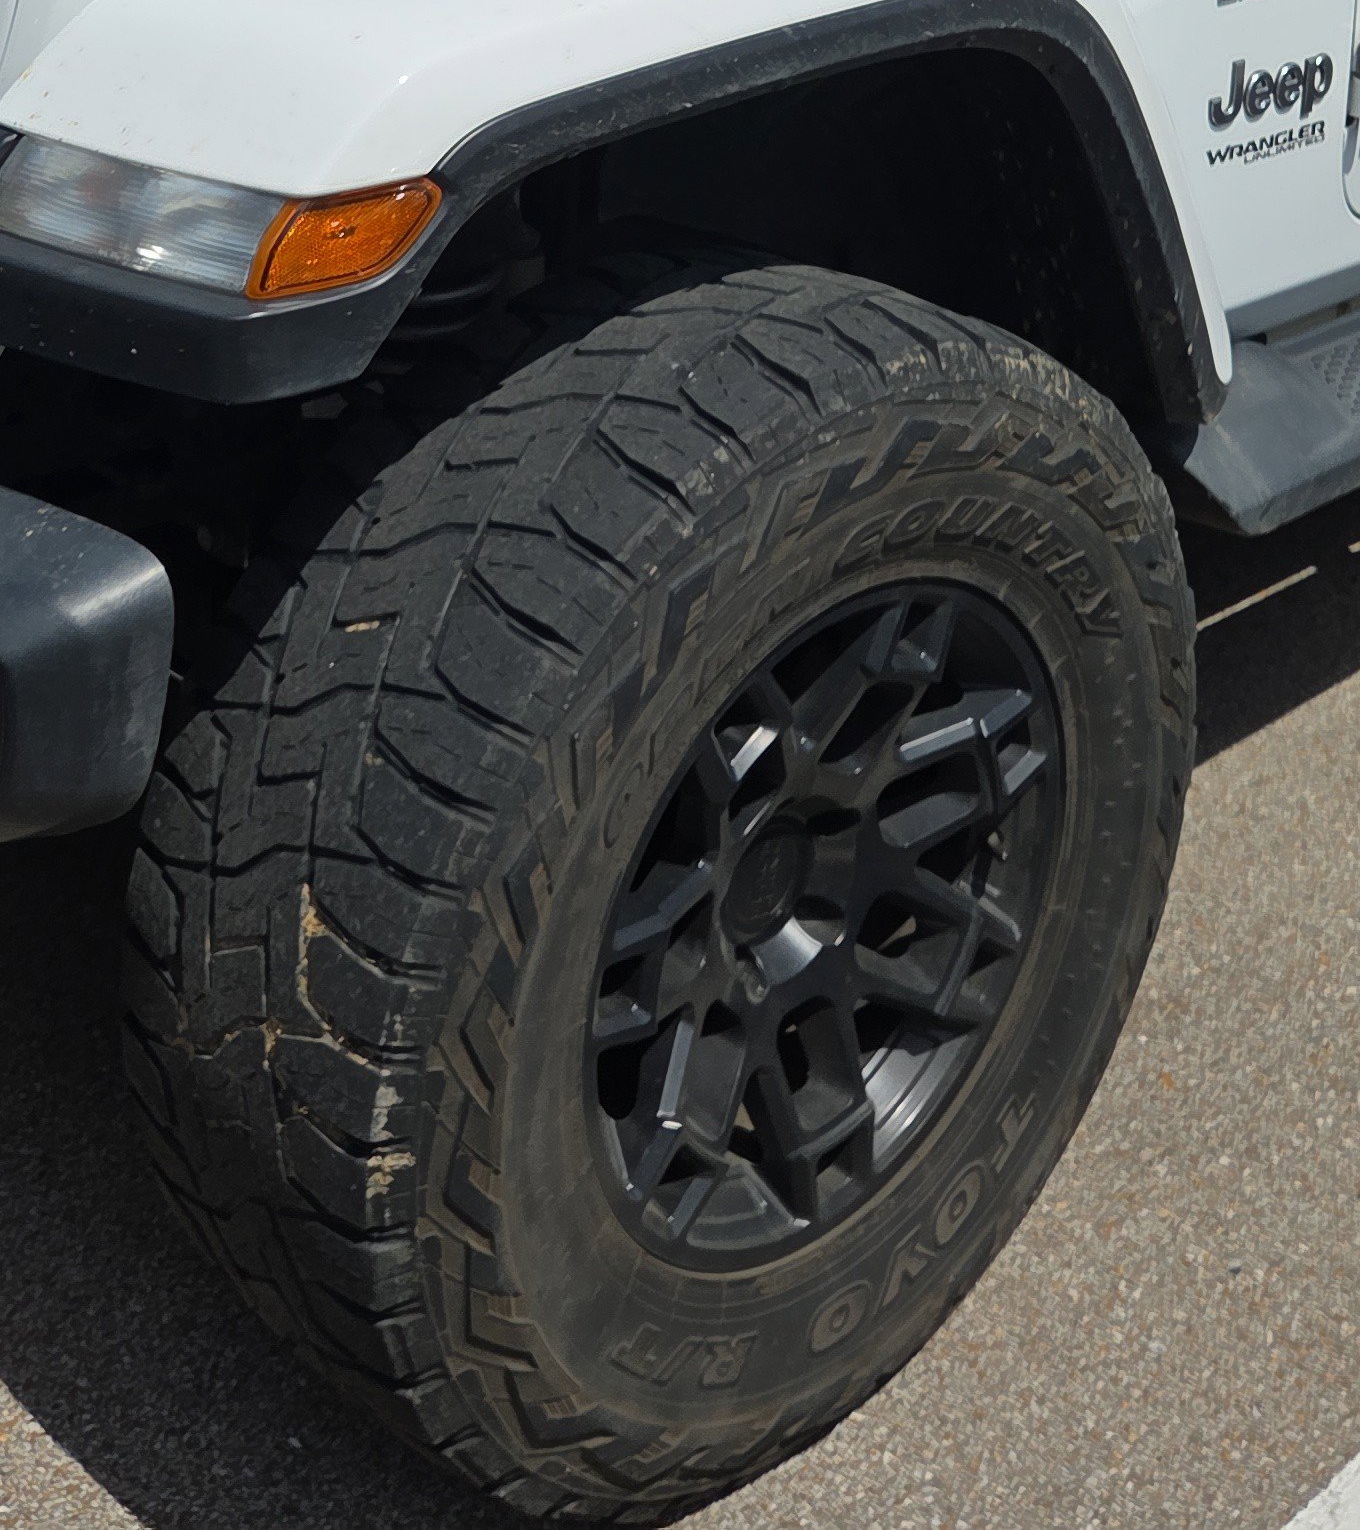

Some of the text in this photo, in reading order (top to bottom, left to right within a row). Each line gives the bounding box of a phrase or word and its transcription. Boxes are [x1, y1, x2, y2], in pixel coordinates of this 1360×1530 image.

[1206, 120, 1325, 166] WRANGLER
[1207, 52, 1334, 132] Jeep
[832, 494, 1124, 642] COUNTRY
[807, 1092, 1038, 1358] TOYO
